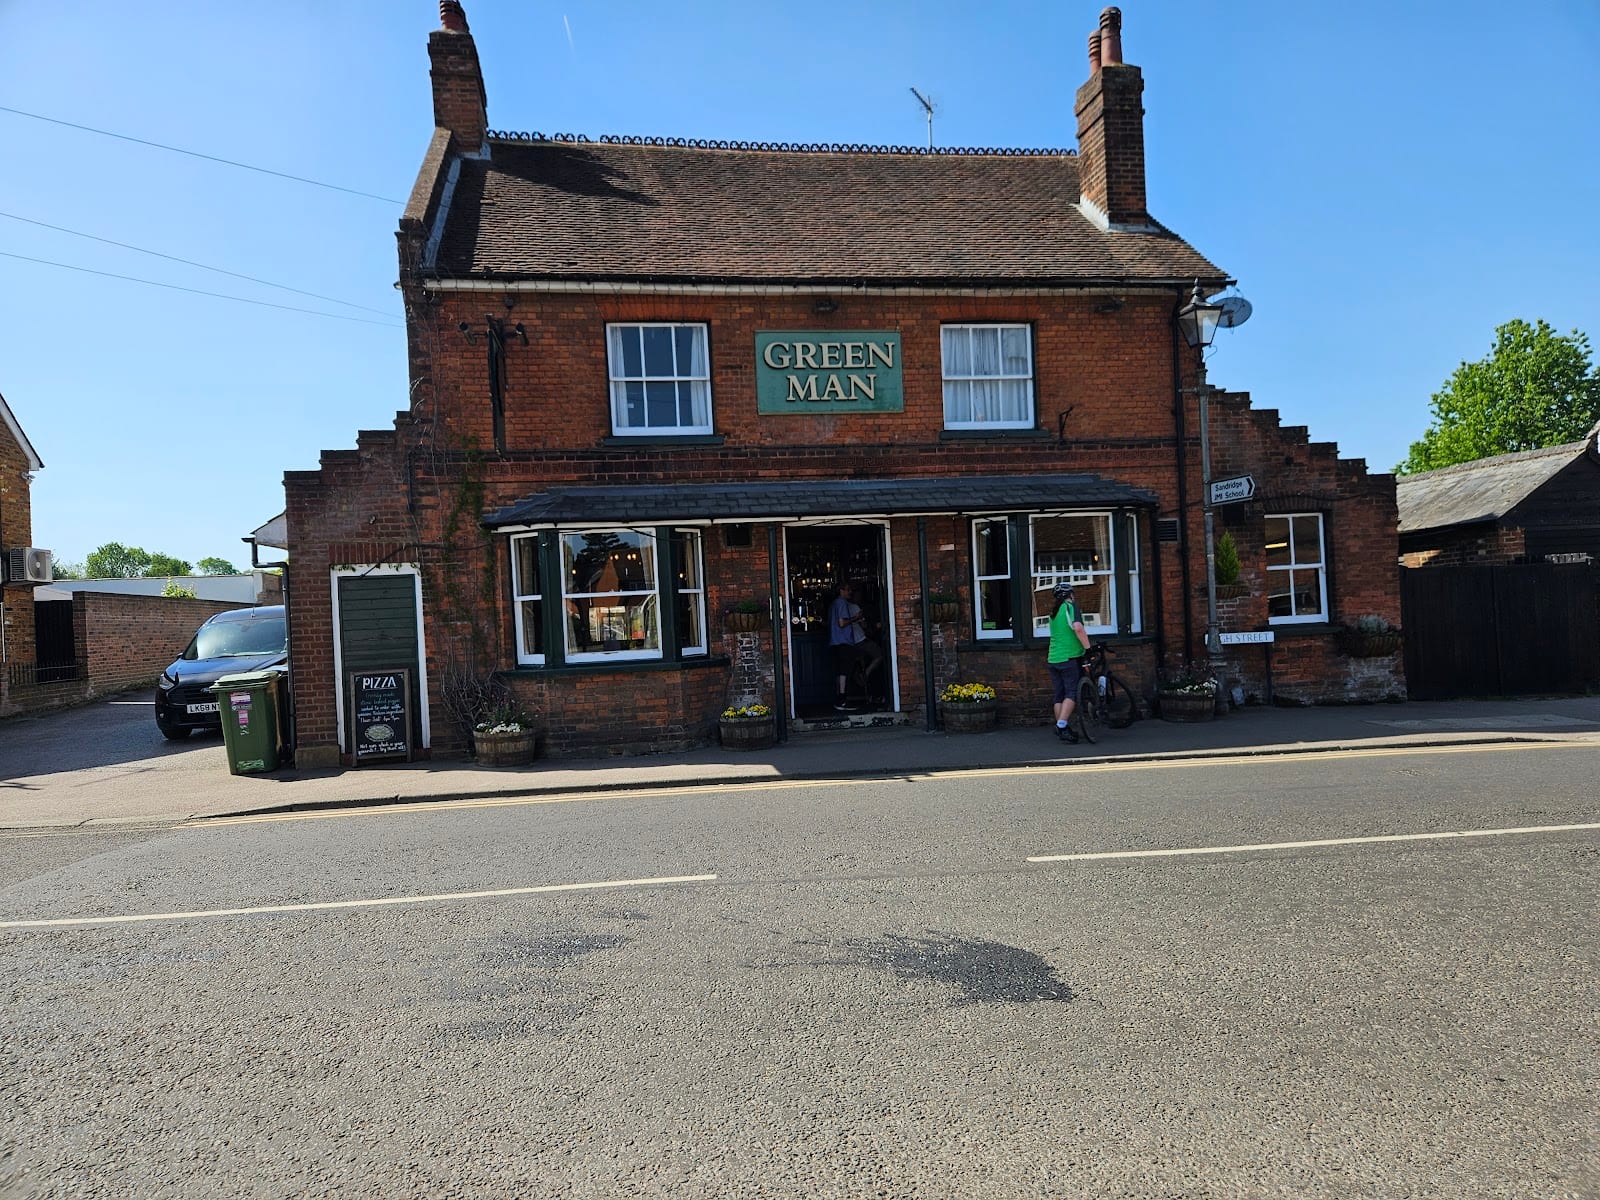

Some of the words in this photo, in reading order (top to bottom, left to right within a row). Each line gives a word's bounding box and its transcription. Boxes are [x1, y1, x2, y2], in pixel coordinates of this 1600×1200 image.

[764, 342, 896, 369] GREEN
[786, 374, 877, 401] MAN
[1225, 489, 1245, 498] School
[1235, 633, 1270, 642] STREET
[363, 676, 397, 689] PIZZA
